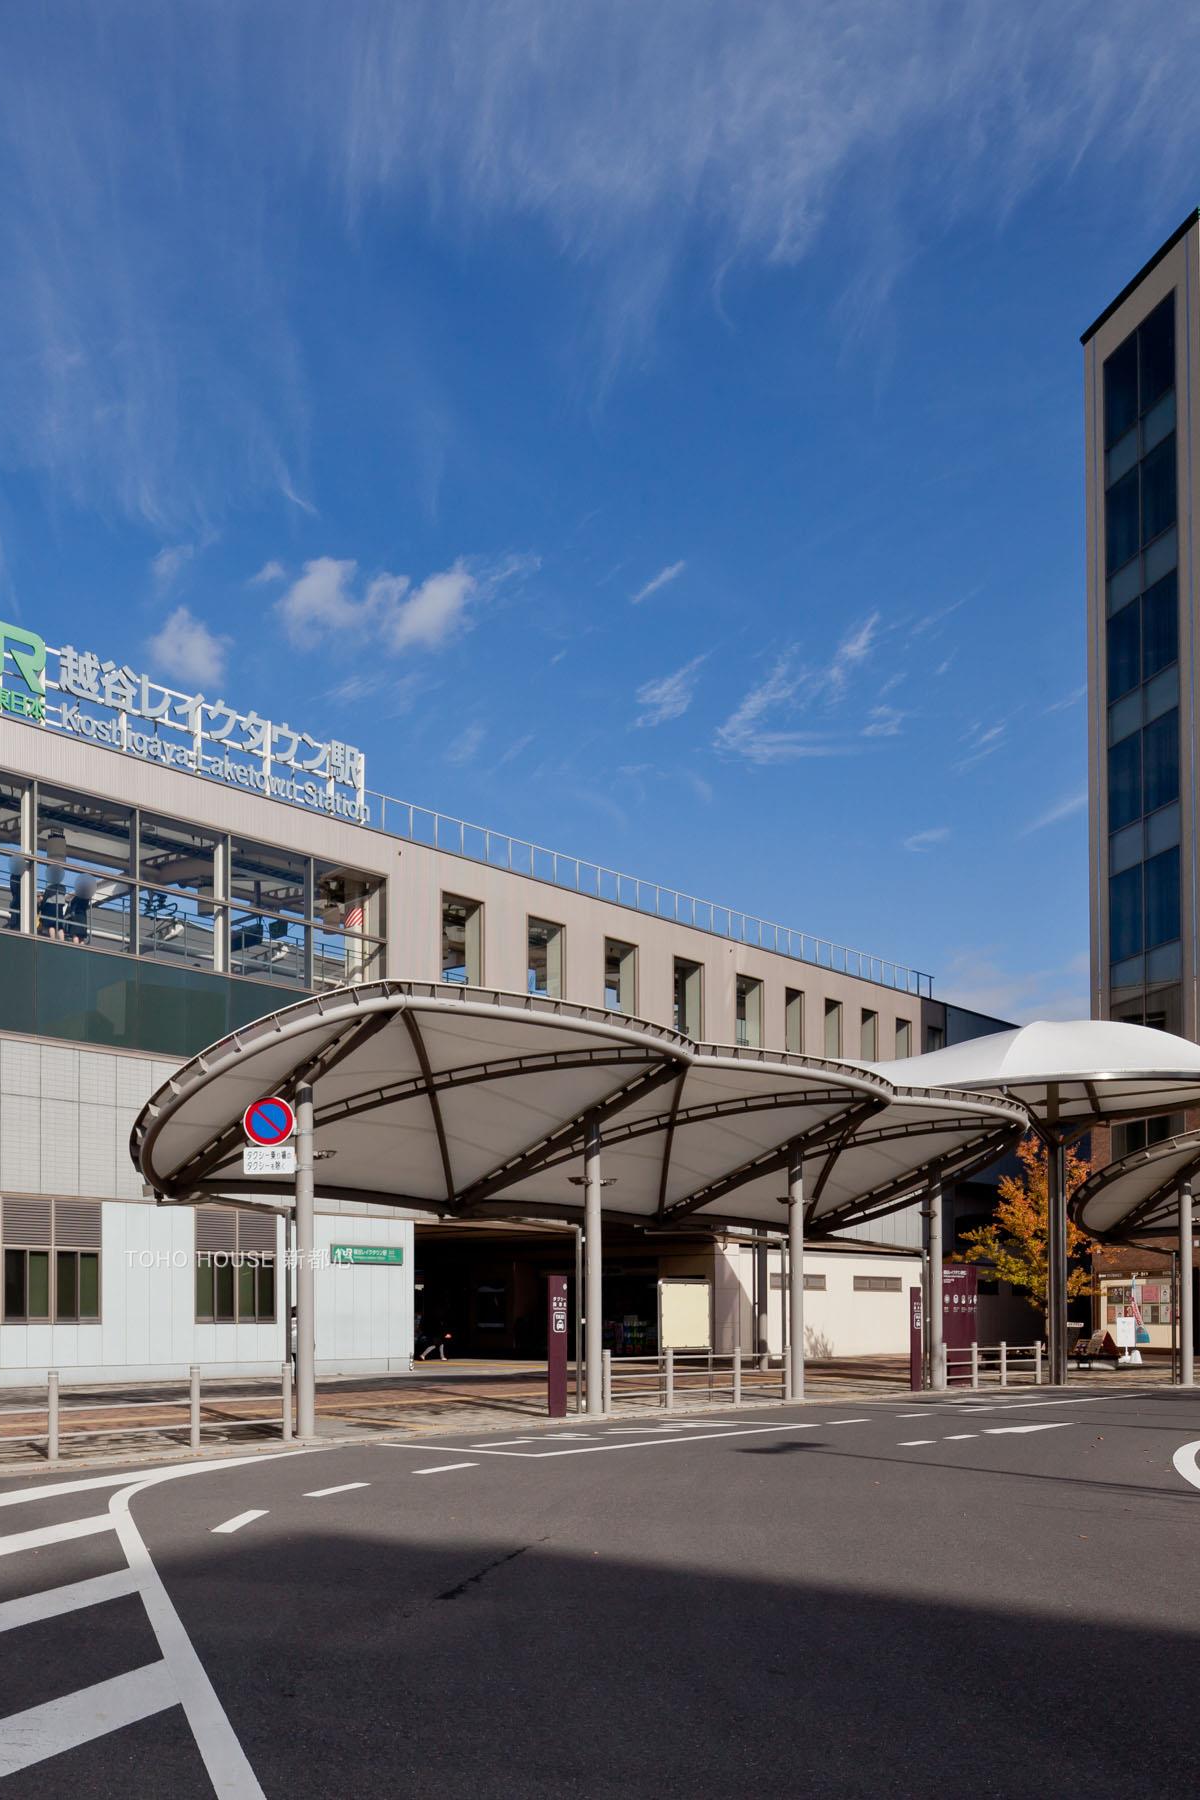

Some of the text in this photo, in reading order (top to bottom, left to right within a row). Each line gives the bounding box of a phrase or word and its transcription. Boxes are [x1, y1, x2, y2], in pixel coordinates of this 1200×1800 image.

[59, 645, 359, 790] 越谷レイクタウン駅
[303, 780, 371, 823] Station
